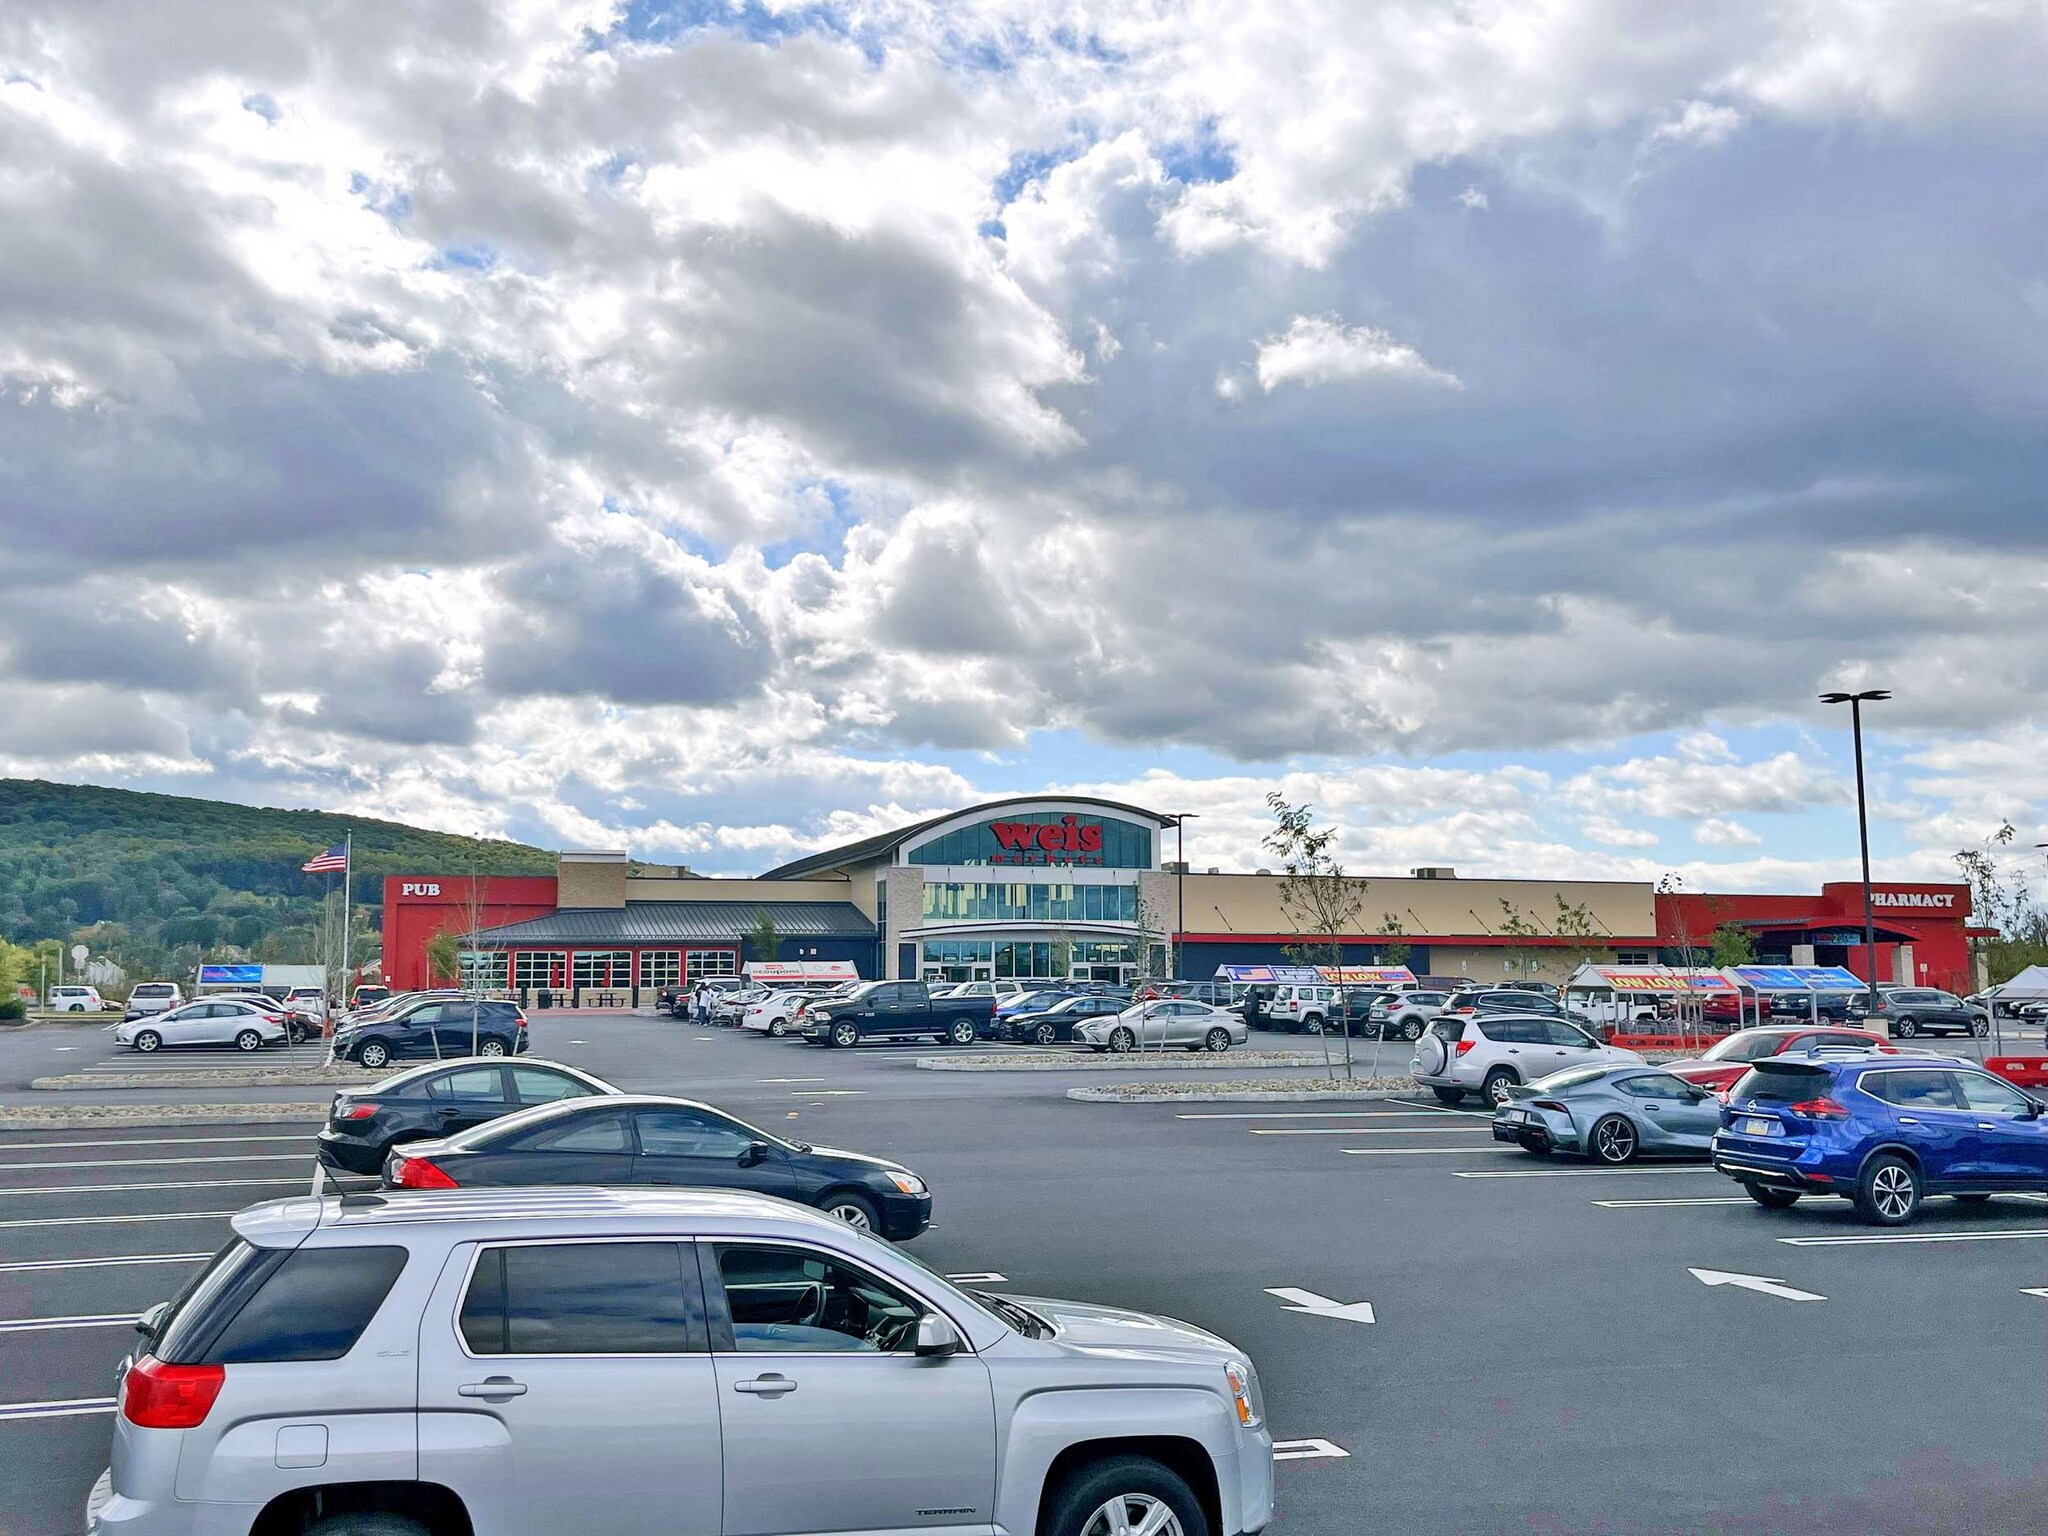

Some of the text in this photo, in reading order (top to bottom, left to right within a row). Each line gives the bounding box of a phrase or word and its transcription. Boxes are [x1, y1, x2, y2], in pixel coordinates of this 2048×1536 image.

[989, 815, 1102, 852] weis
[402, 883, 441, 896] PUB
[915, 1507, 976, 1516] TERRAIN
